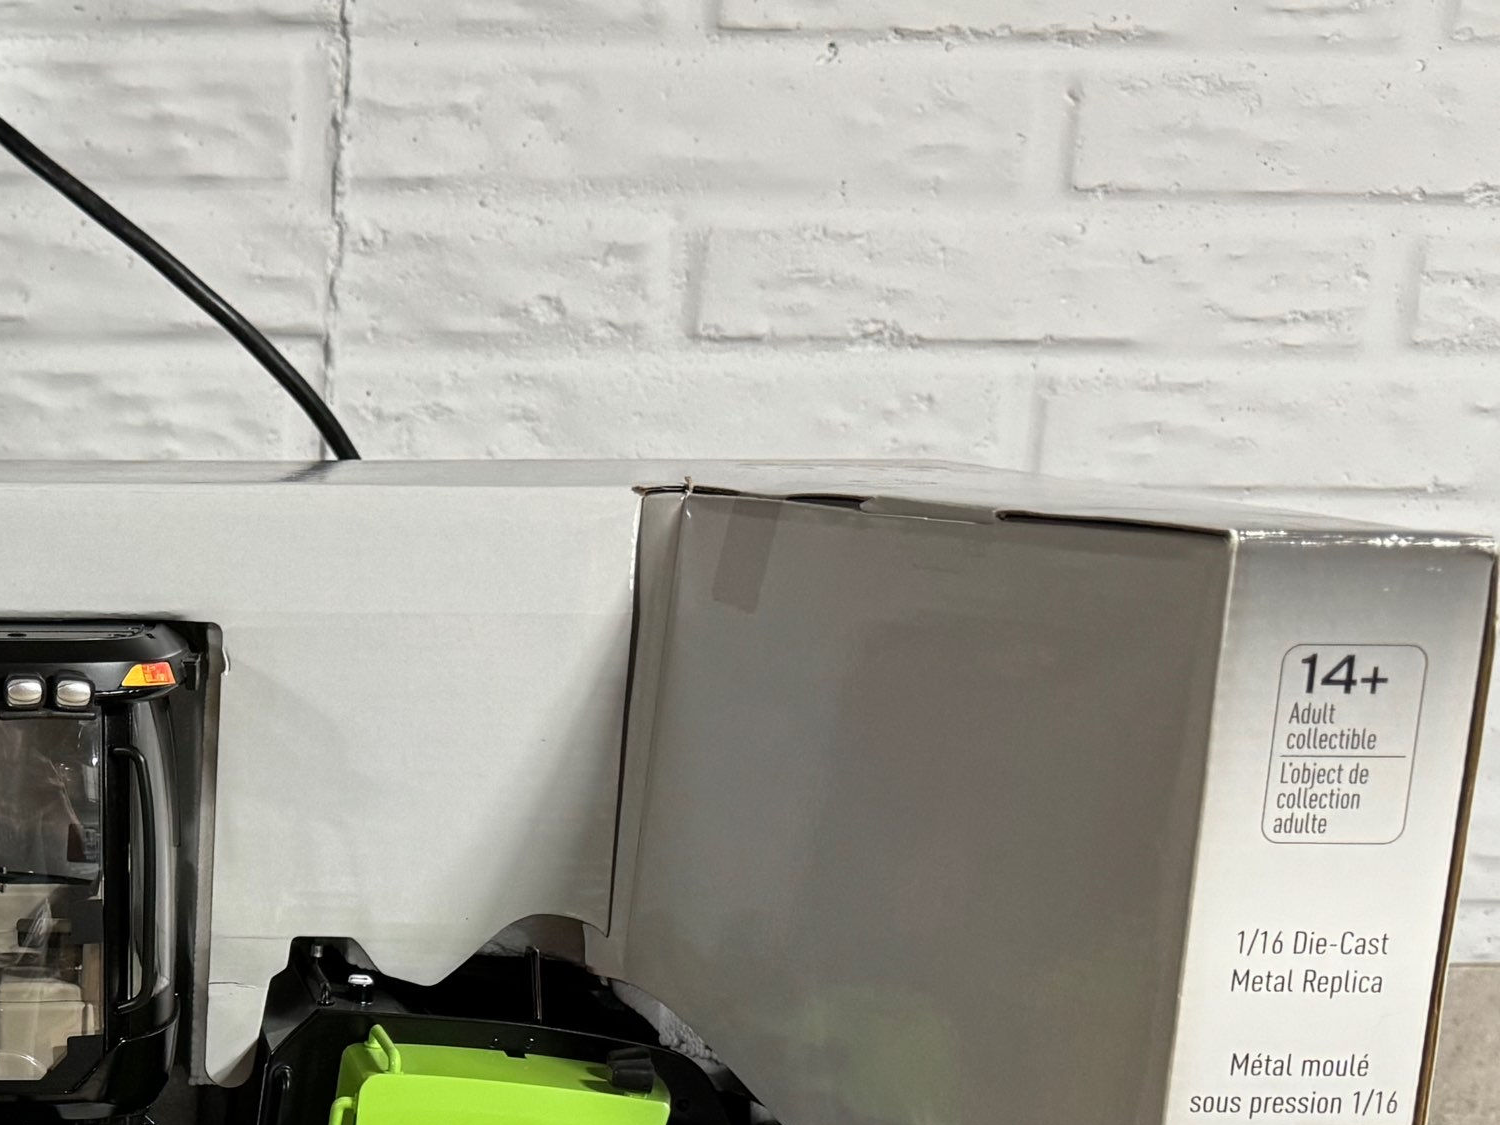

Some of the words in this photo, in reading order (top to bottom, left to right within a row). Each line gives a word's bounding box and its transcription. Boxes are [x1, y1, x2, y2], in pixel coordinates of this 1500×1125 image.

[1301, 653, 1389, 694] 14+
[1288, 702, 1336, 725] Adult
[1286, 727, 1377, 750] collectible
[1280, 762, 1344, 789] L'object
[1348, 762, 1370, 785] de
[1276, 787, 1361, 810] collection
[1273, 812, 1327, 834] adulte
[1237, 928, 1284, 956] 1/16
[1292, 930, 1390, 956] Die-Cast
[1230, 968, 1294, 993] Metal
[1302, 968, 1384, 999] Replica
[1229, 1052, 1293, 1077] Métal
[1300, 1053, 1370, 1077] moulé
[1189, 1094, 1242, 1114] sous
[1248, 1090, 1343, 1120] pression
[1352, 1088, 1398, 1117] 1/16
